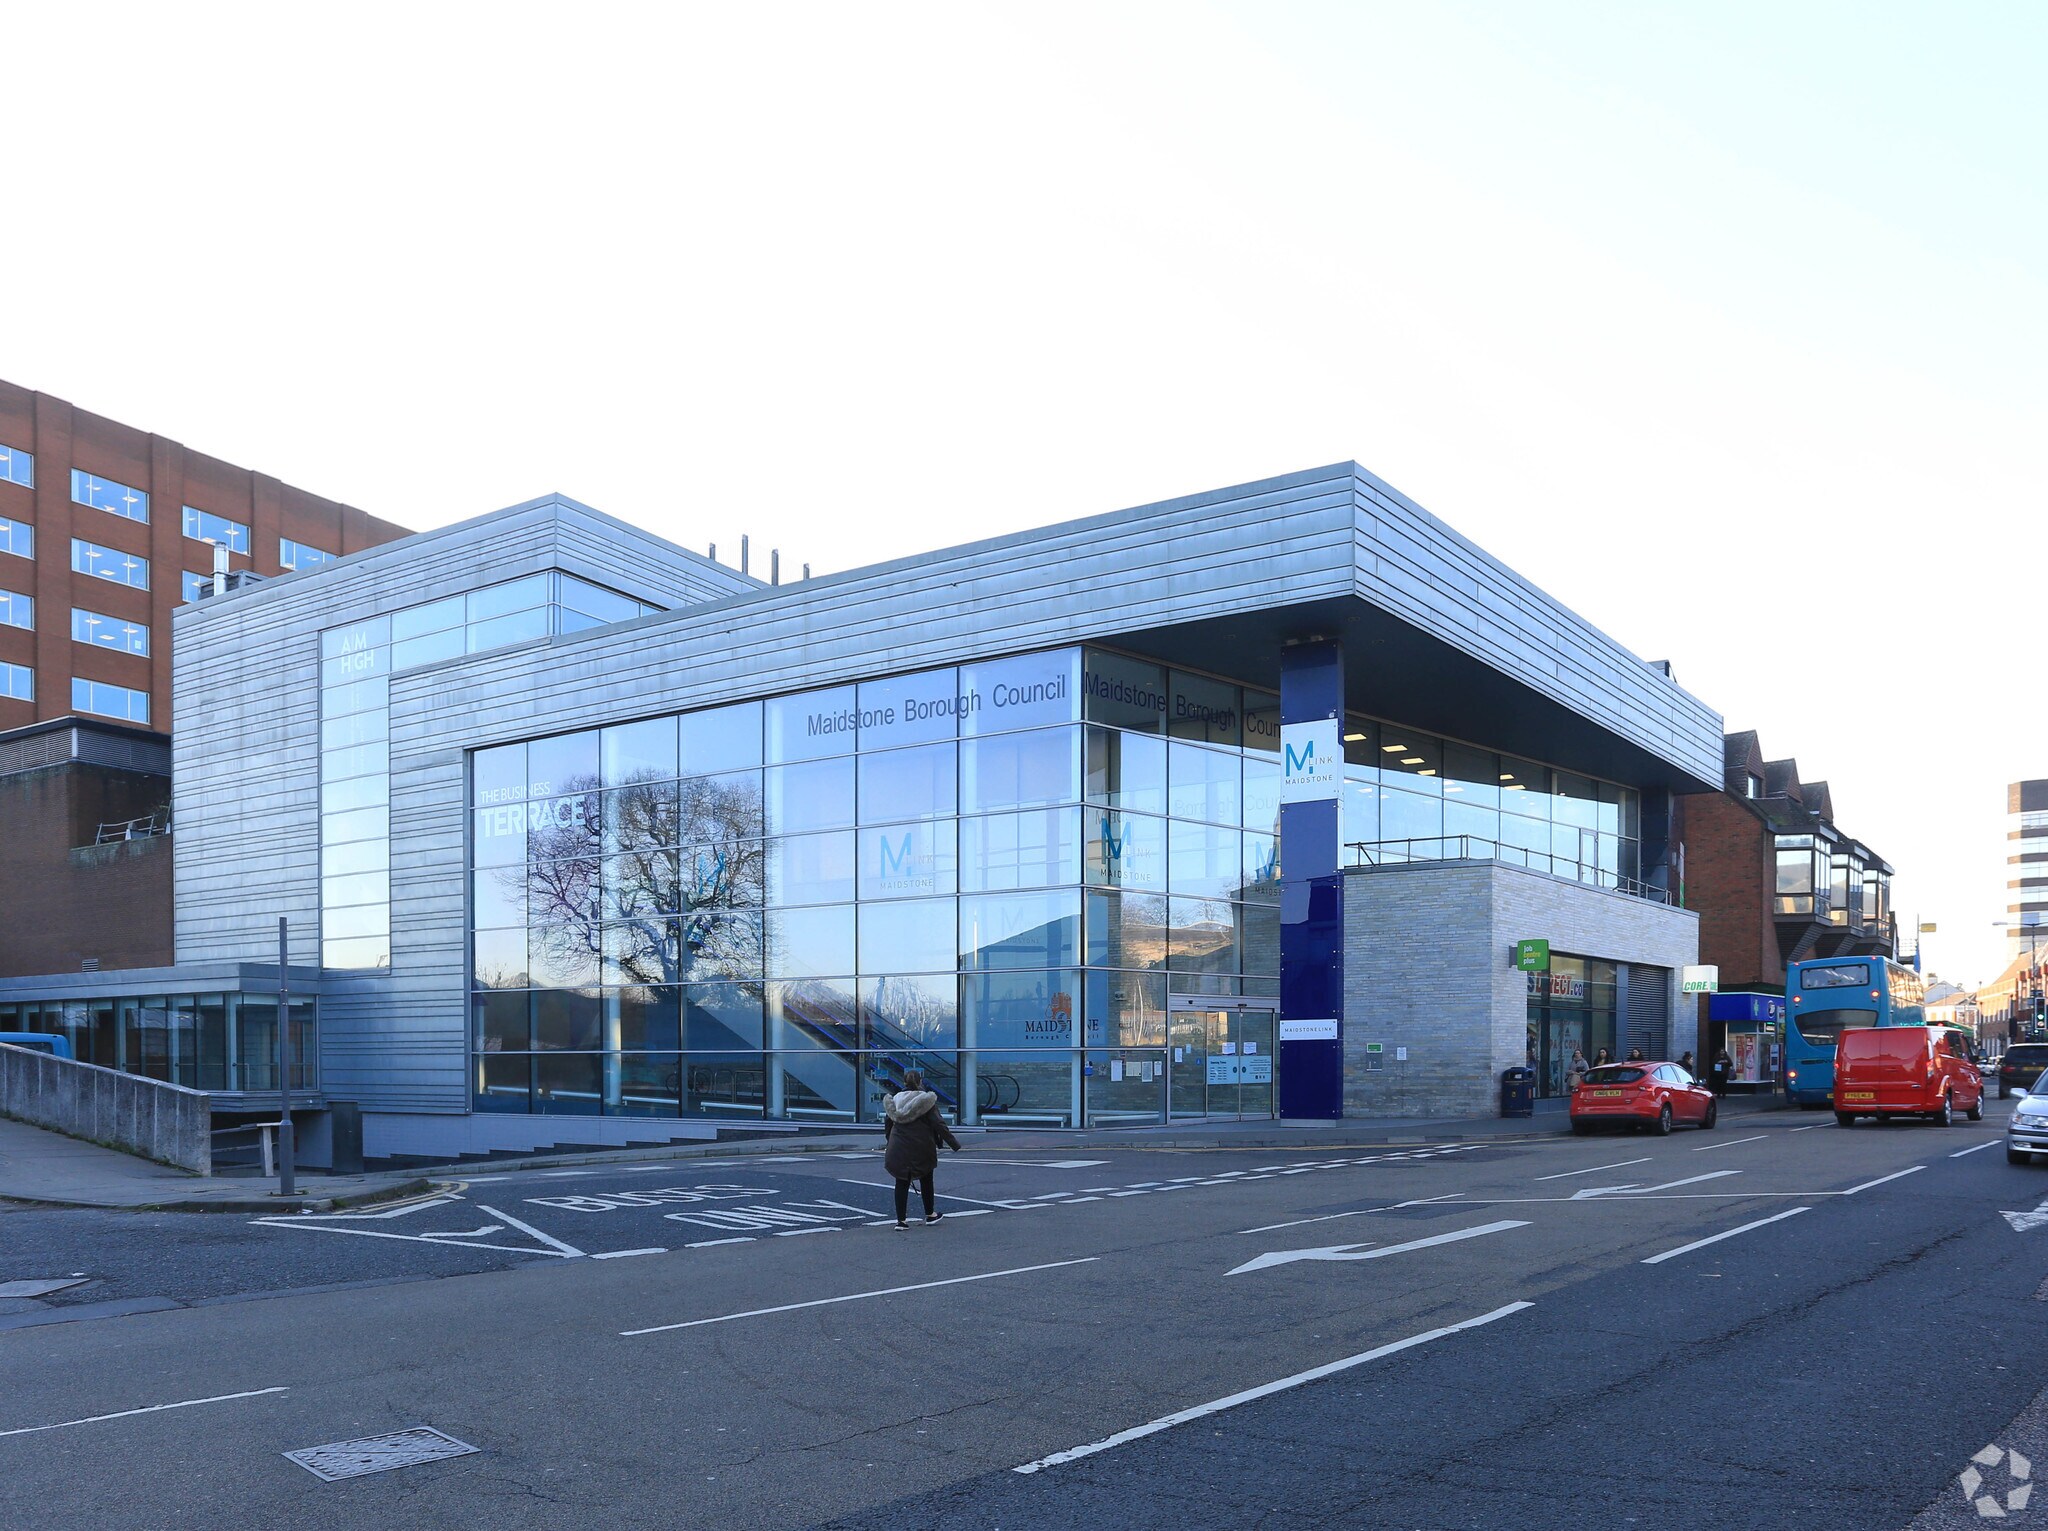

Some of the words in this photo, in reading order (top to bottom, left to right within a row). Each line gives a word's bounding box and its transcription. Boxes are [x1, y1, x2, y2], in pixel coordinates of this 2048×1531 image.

[808, 707, 894, 737] Maidstone
[904, 689, 981, 720] Borough
[993, 674, 1066, 708] Council
[1085, 671, 1166, 712] Maidstone
[1176, 694, 1236, 732] Borough
[1285, 740, 1314, 777] M
[1308, 756, 1333, 766] LINK
[481, 789, 500, 804] THE
[501, 782, 551, 801] BUSINESS
[1285, 774, 1333, 785] MAIDSTONE
[480, 795, 586, 838] TERRACE
[880, 832, 912, 879] M
[1101, 818, 1132, 868] M
[880, 878, 934, 890] MAIDSTONE
[1100, 868, 1152, 882] MAIDSTONE
[1523, 945, 1533, 953] job
[1523, 957, 1535, 965] plus
[523, 1183, 781, 1212] BUSES
[664, 1199, 888, 1231] ONLY
